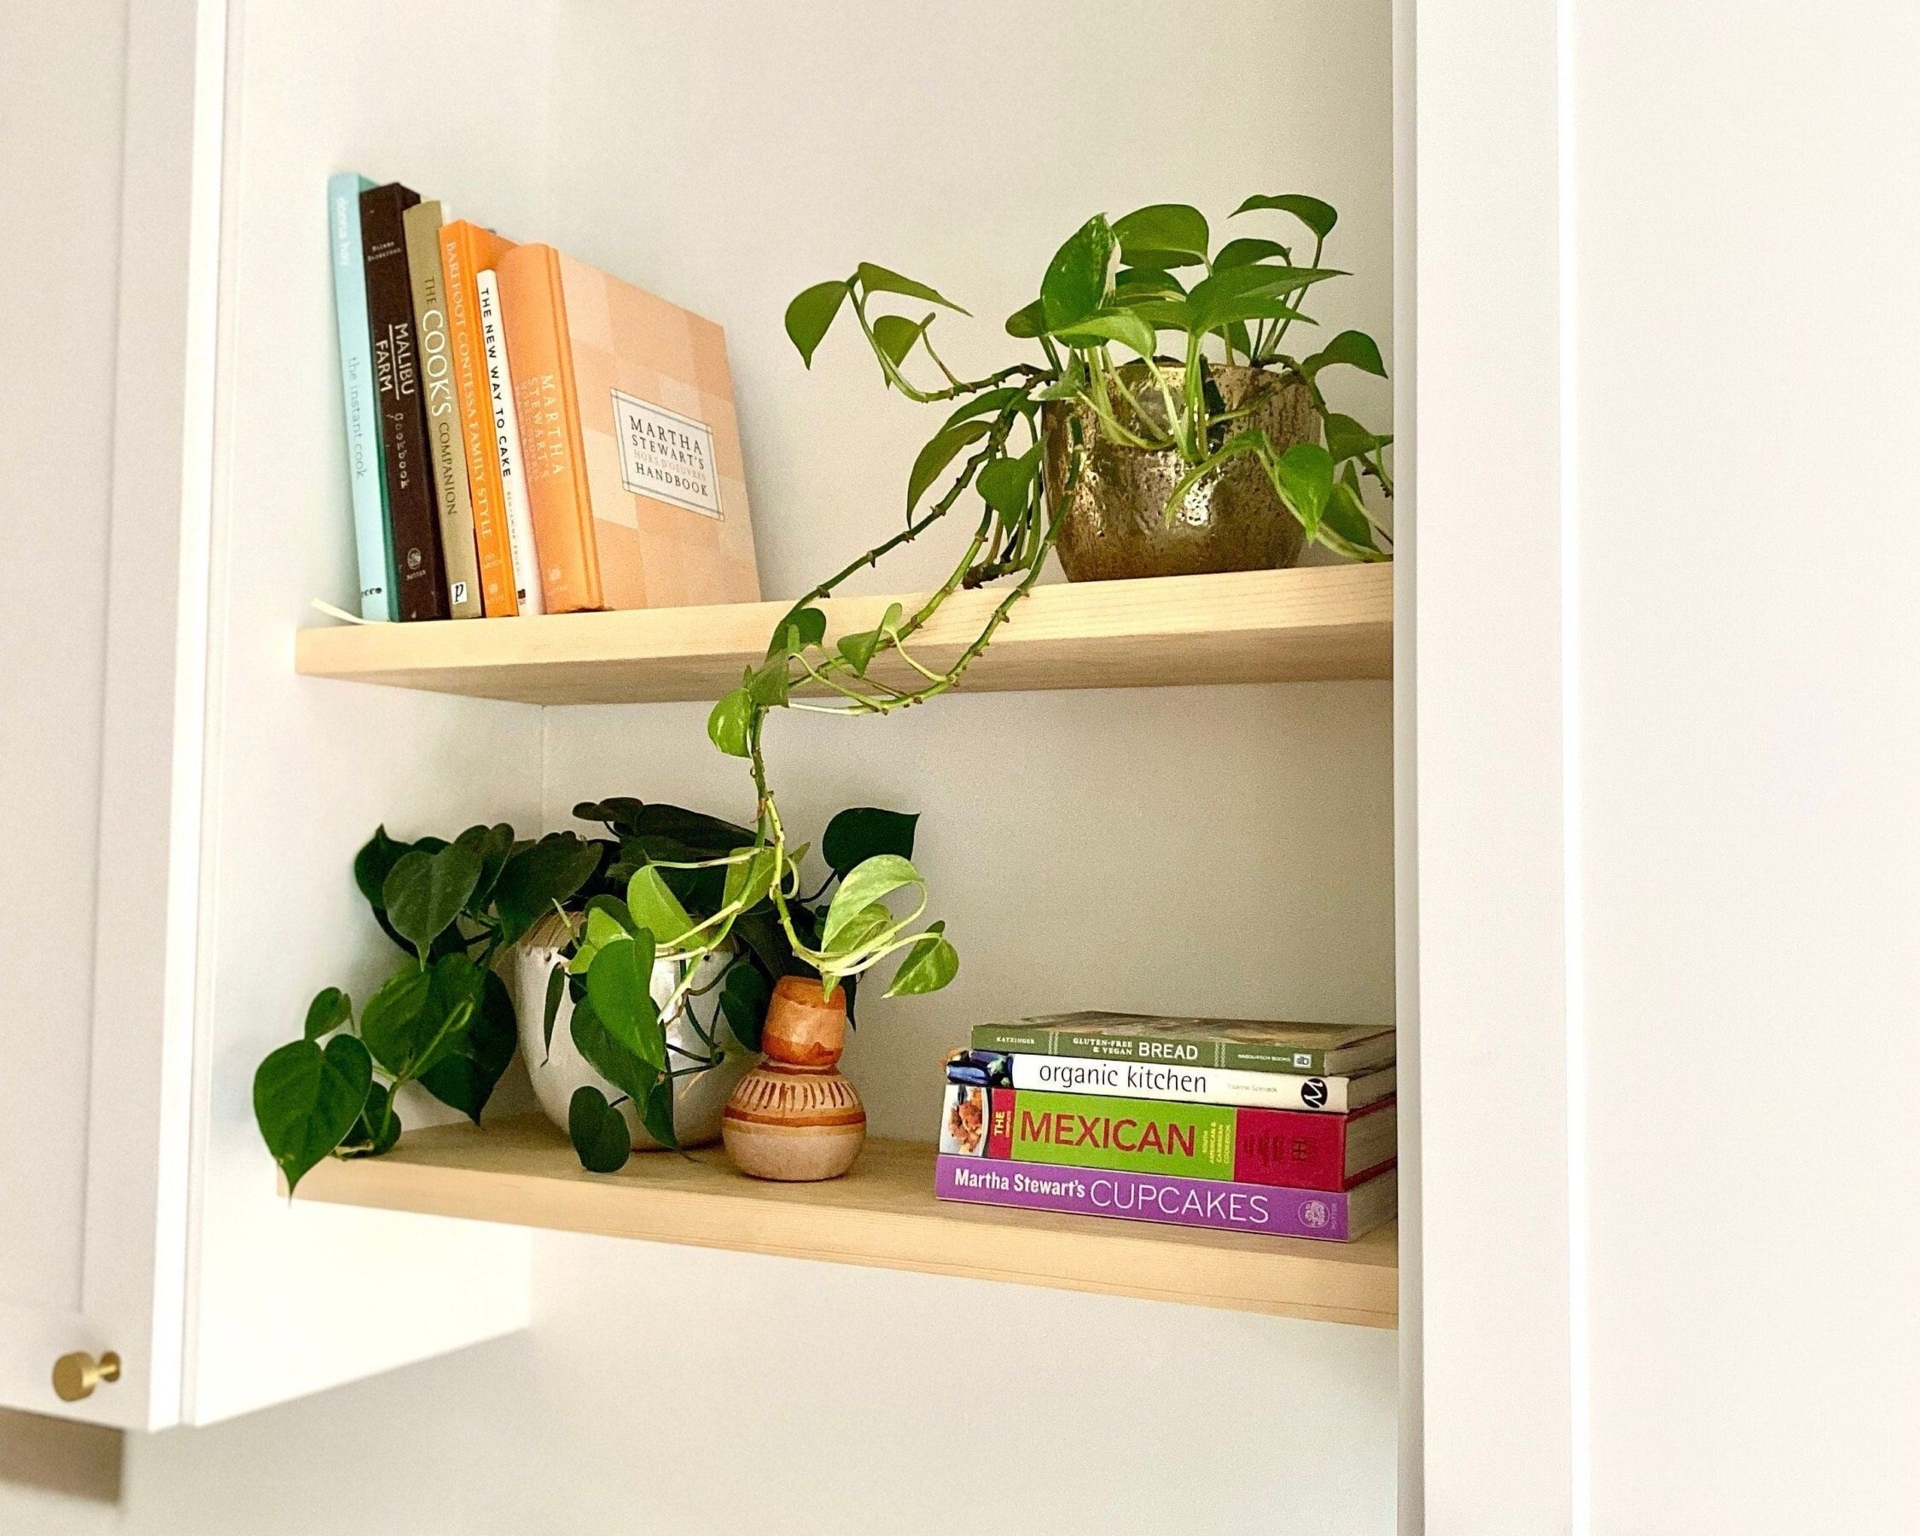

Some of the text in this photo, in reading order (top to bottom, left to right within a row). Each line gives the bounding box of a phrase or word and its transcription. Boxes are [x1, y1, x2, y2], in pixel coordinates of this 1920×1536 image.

[375, 339, 393, 392] FARM
[394, 323, 415, 395] MALIBU
[422, 276, 457, 515] THE COOK'S COMPANION
[446, 242, 492, 539] BAREFOOT CONTESSA FAMILY STYLE
[481, 288, 511, 477] THE NEW WAY TO CAKE
[348, 355, 367, 479] the instant cook
[527, 376, 550, 478] STEWART'S
[540, 374, 565, 474] MARTHA
[629, 414, 702, 455] MARTHA
[631, 434, 704, 470] STEWART'S
[635, 461, 708, 496] HANDBOOK
[996, 1036, 1035, 1045] KATZINGER
[1073, 1037, 1133, 1048] GLUTEN-FREE
[1102, 1047, 1133, 1056] VEGAN
[1138, 1041, 1198, 1060] BREAD
[1039, 1063, 1206, 1093] organic kitchen
[993, 1110, 1005, 1136] THE
[1020, 1110, 1195, 1157] MEXICAN
[1216, 1124, 1224, 1163] CARIBBEAN
[1223, 1124, 1231, 1164] COOKBOOK
[955, 1168, 1269, 1223] Martha Stewart's CUPCAKES
